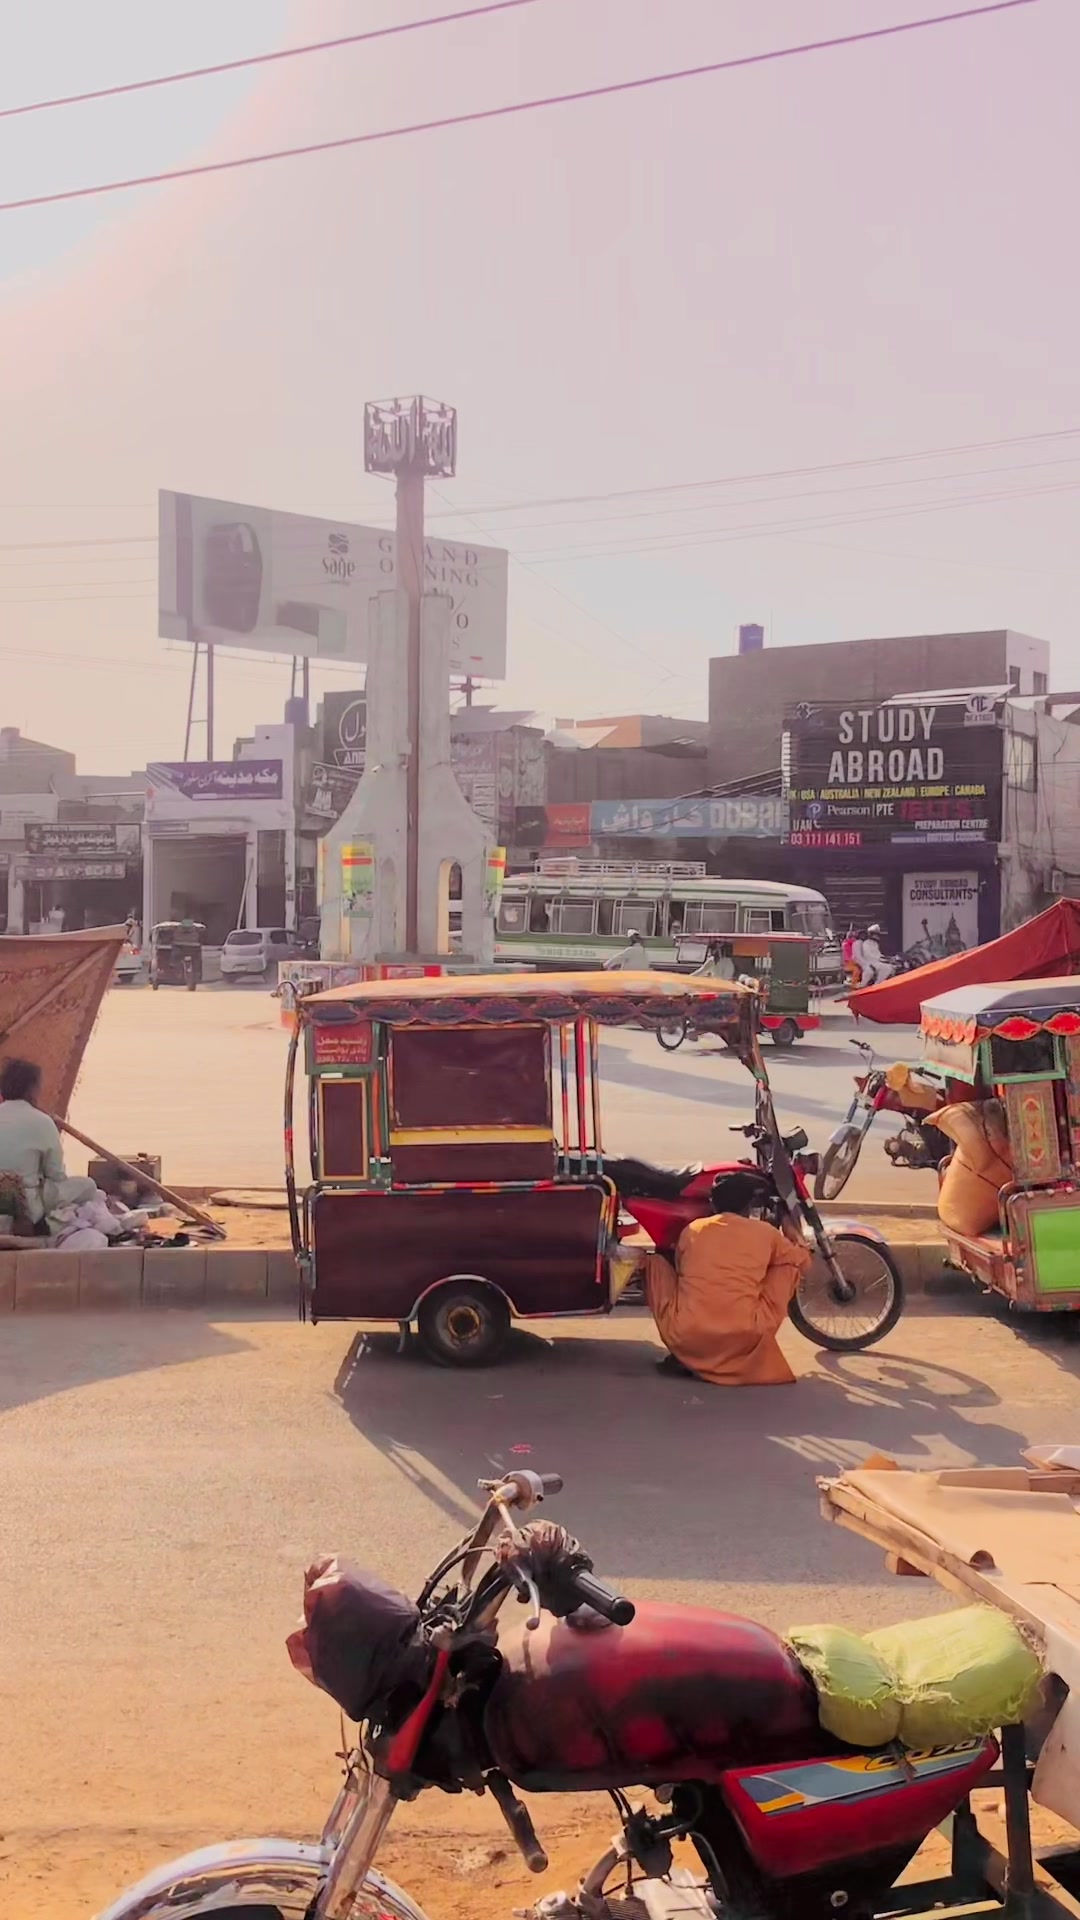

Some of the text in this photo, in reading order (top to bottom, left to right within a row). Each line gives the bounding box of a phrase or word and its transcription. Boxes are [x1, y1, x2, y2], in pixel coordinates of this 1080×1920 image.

[378, 536, 478, 567] GAND
[380, 557, 479, 588] ONING
[838, 707, 936, 744] STUDY
[827, 748, 944, 783] ABROAD
[801, 788, 816, 800] USA
[819, 787, 860, 800] AUSTRALIA
[864, 787, 882, 799] NEW
[882, 786, 916, 799] ZEALAND
[920, 785, 950, 797] EUROPE
[955, 784, 986, 796] CANADA
[827, 804, 871, 816] Pearson
[876, 803, 895, 816] PTE
[793, 819, 813, 832] UAN
[914, 818, 990, 830] PREPARATION CENTRE
[790, 833, 803, 845] 03
[909, 888, 973, 901] CONSULTANTS
